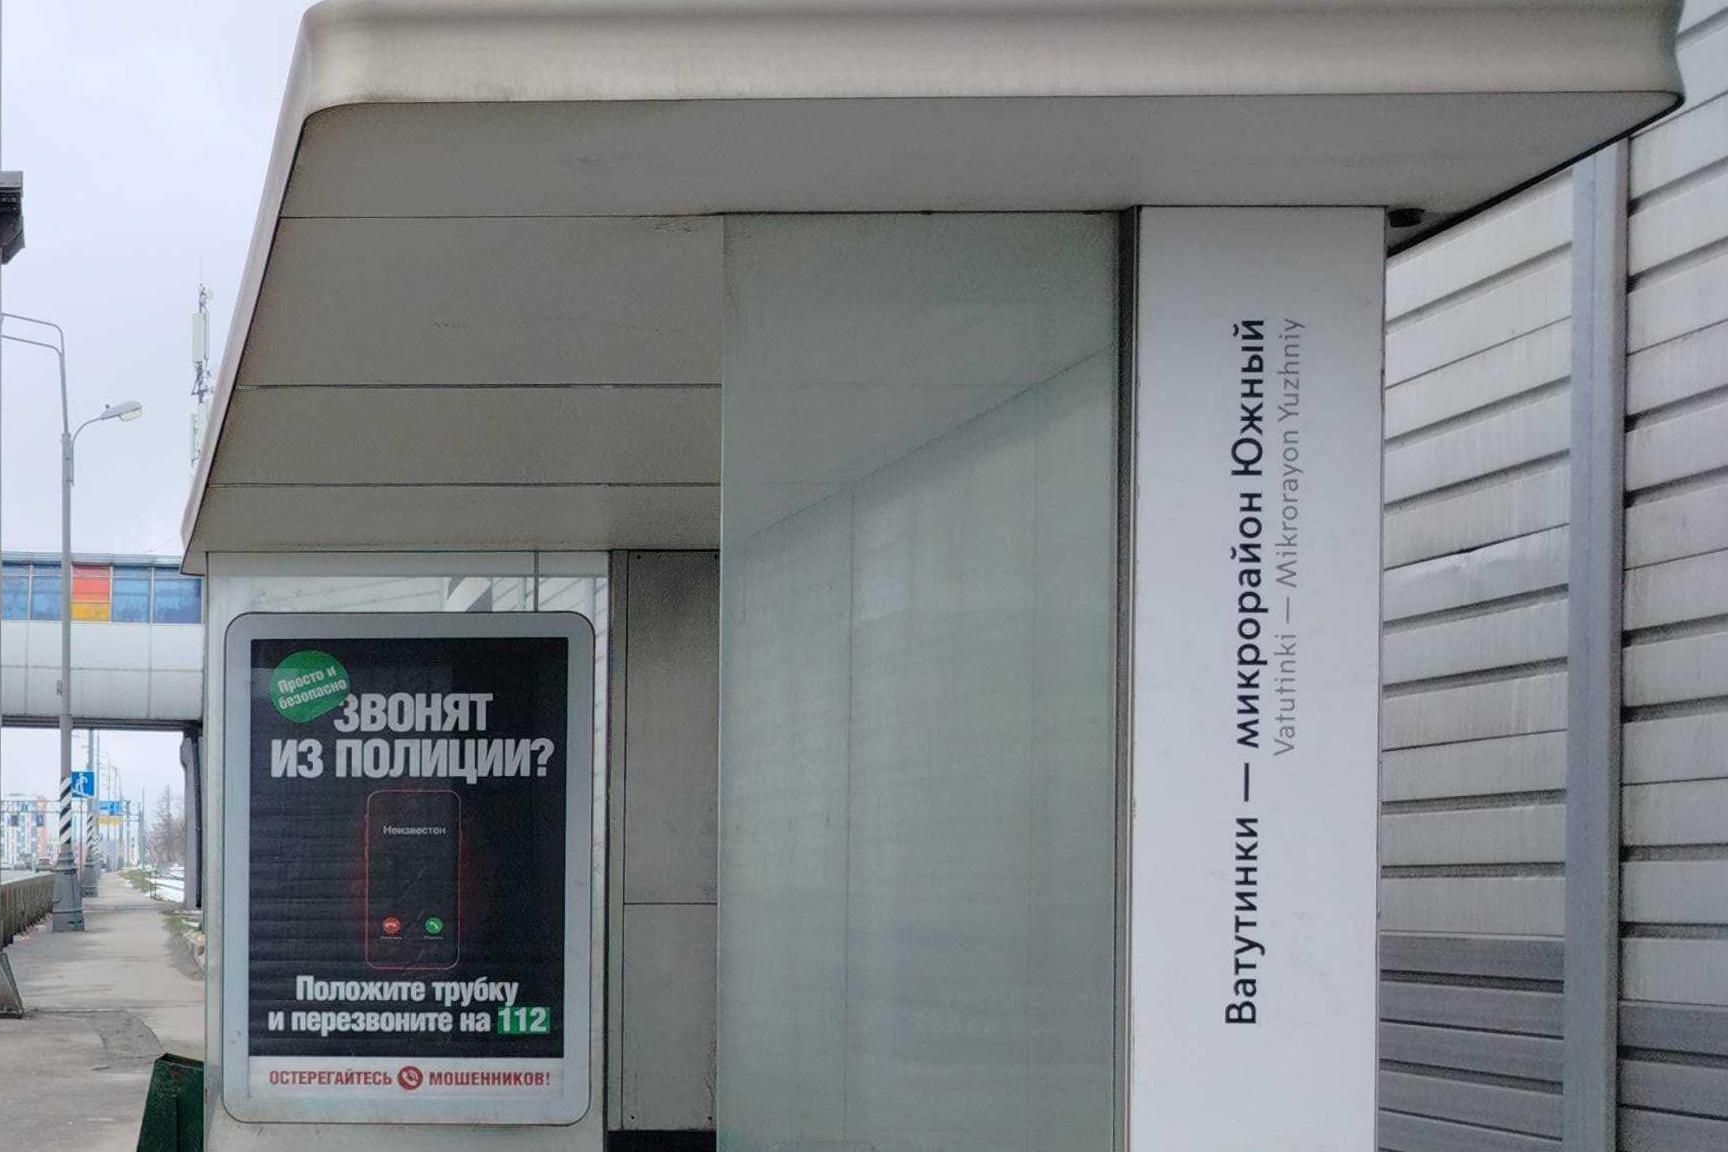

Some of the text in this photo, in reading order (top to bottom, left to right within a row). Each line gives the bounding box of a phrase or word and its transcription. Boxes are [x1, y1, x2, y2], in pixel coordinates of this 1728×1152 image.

[1277, 318, 1306, 422] Yuzhniy
[1231, 320, 1264, 476] Южный
[1275, 430, 1303, 588] Mikrorayon
[1230, 493, 1269, 748] микрорайон
[277, 666, 336, 694] Просто и
[278, 679, 348, 710] безопасно
[1273, 634, 1297, 757] Vatutinki
[333, 693, 493, 732] ЗВОНЯТ
[271, 737, 555, 784] ИЗ ПОЛИЦИИ?
[1225, 818, 1265, 1024] Ватутинки
[296, 975, 519, 1007] Положите трубку
[268, 1007, 547, 1036] и перезвоните на 112
[269, 1068, 550, 1086] ОСТЕРЕГАЙТЕСЬ МОШЕННИКОВ!
